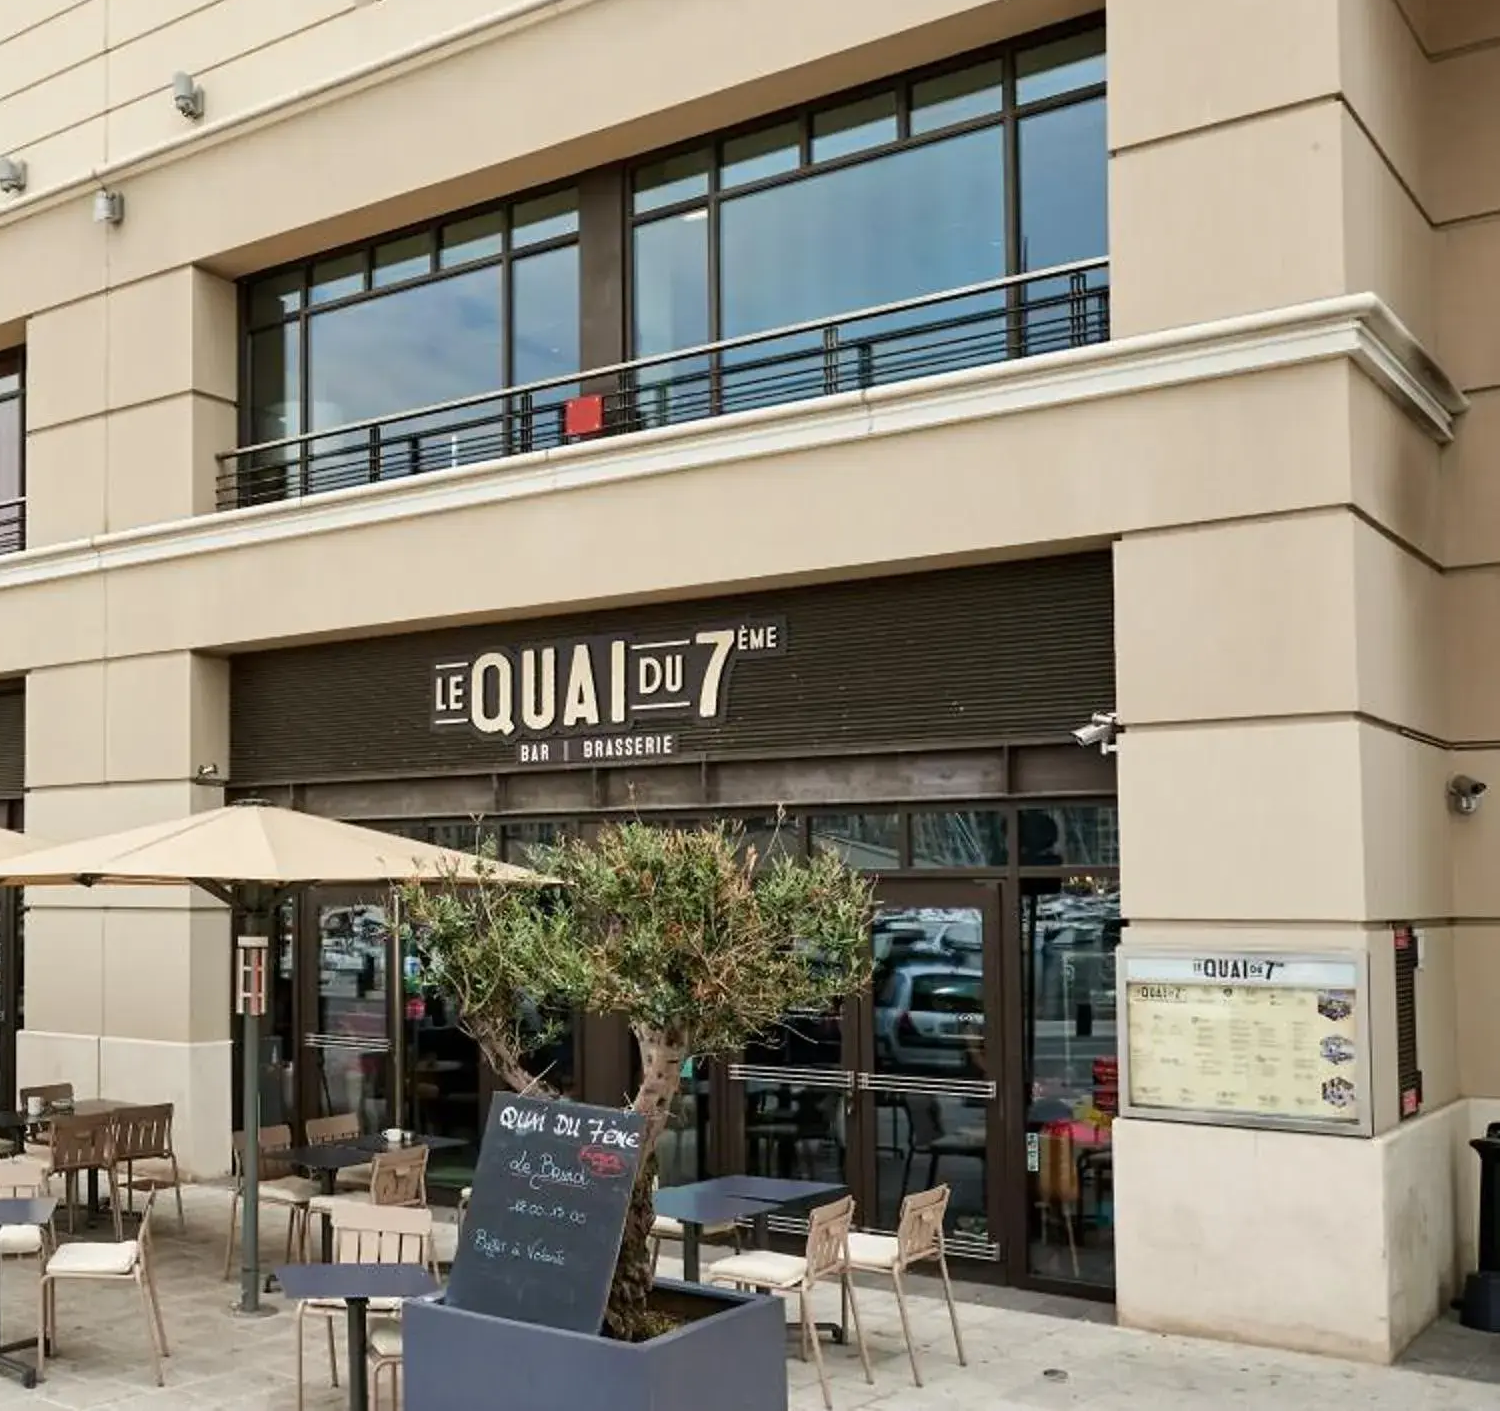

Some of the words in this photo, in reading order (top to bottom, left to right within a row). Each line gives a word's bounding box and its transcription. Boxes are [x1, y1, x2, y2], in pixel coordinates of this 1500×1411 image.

[435, 674, 464, 711] LE
[470, 640, 626, 736] QUAI
[638, 655, 684, 695] DU
[520, 745, 550, 761] BAR
[582, 736, 673, 759] BRASSERIE
[1203, 958, 1248, 980] QUAI
